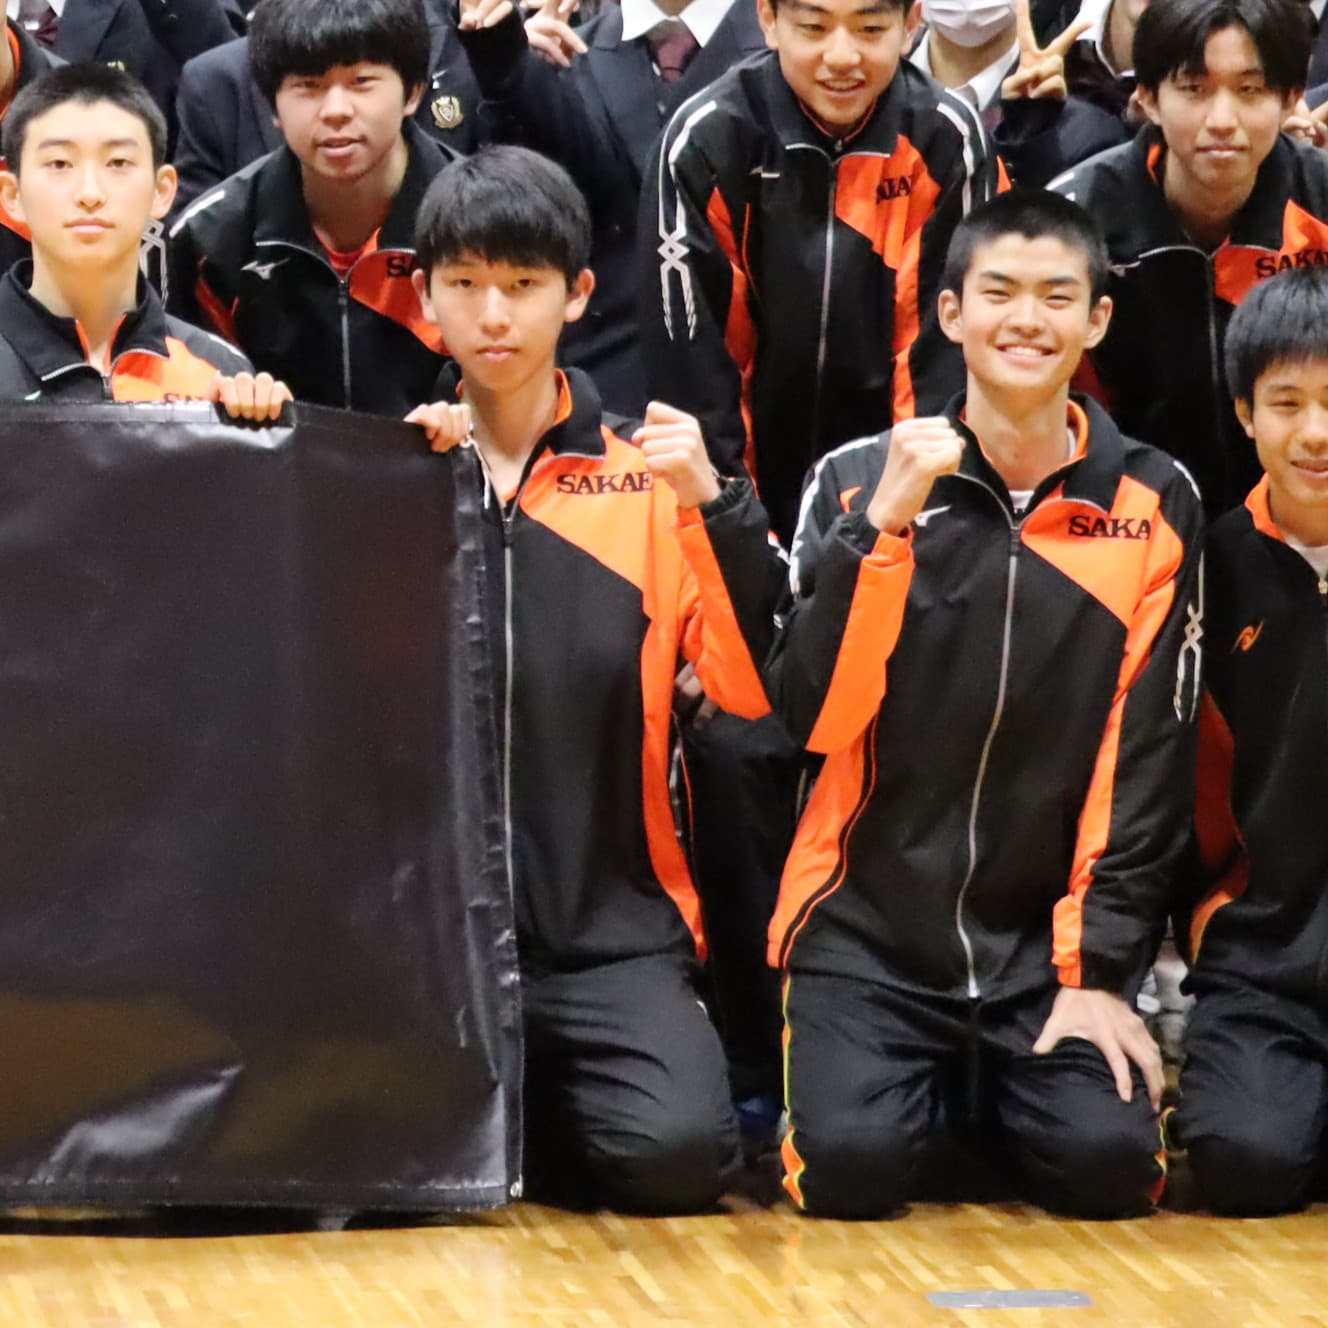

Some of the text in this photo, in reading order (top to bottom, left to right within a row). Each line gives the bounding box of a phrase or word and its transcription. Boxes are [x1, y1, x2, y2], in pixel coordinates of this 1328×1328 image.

[1255, 249, 1328, 280] SAKA
[556, 471, 654, 495] SAKAE
[1068, 514, 1152, 541] SAKA
